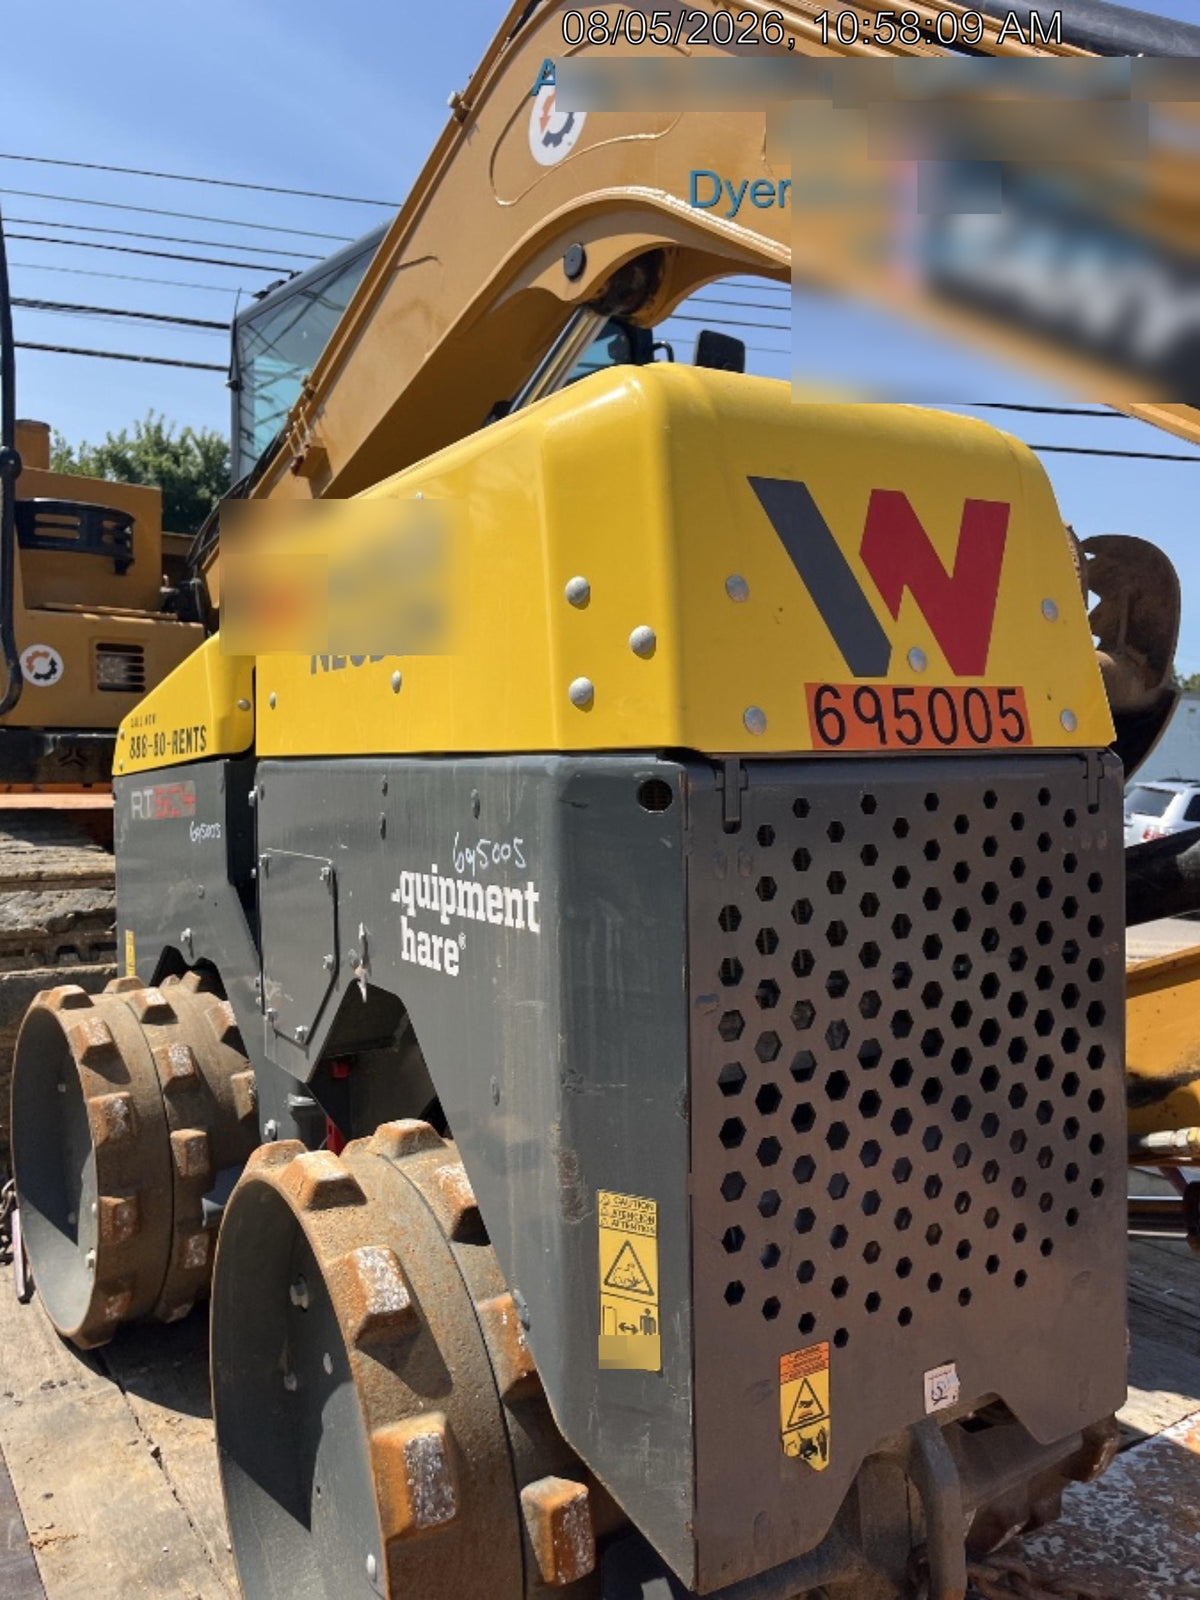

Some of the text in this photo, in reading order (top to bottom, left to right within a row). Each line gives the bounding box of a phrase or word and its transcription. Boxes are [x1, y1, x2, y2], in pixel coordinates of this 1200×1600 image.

[813, 685, 1026, 746] 695005
[452, 831, 527, 877] 695005
[391, 863, 541, 934] quipment
